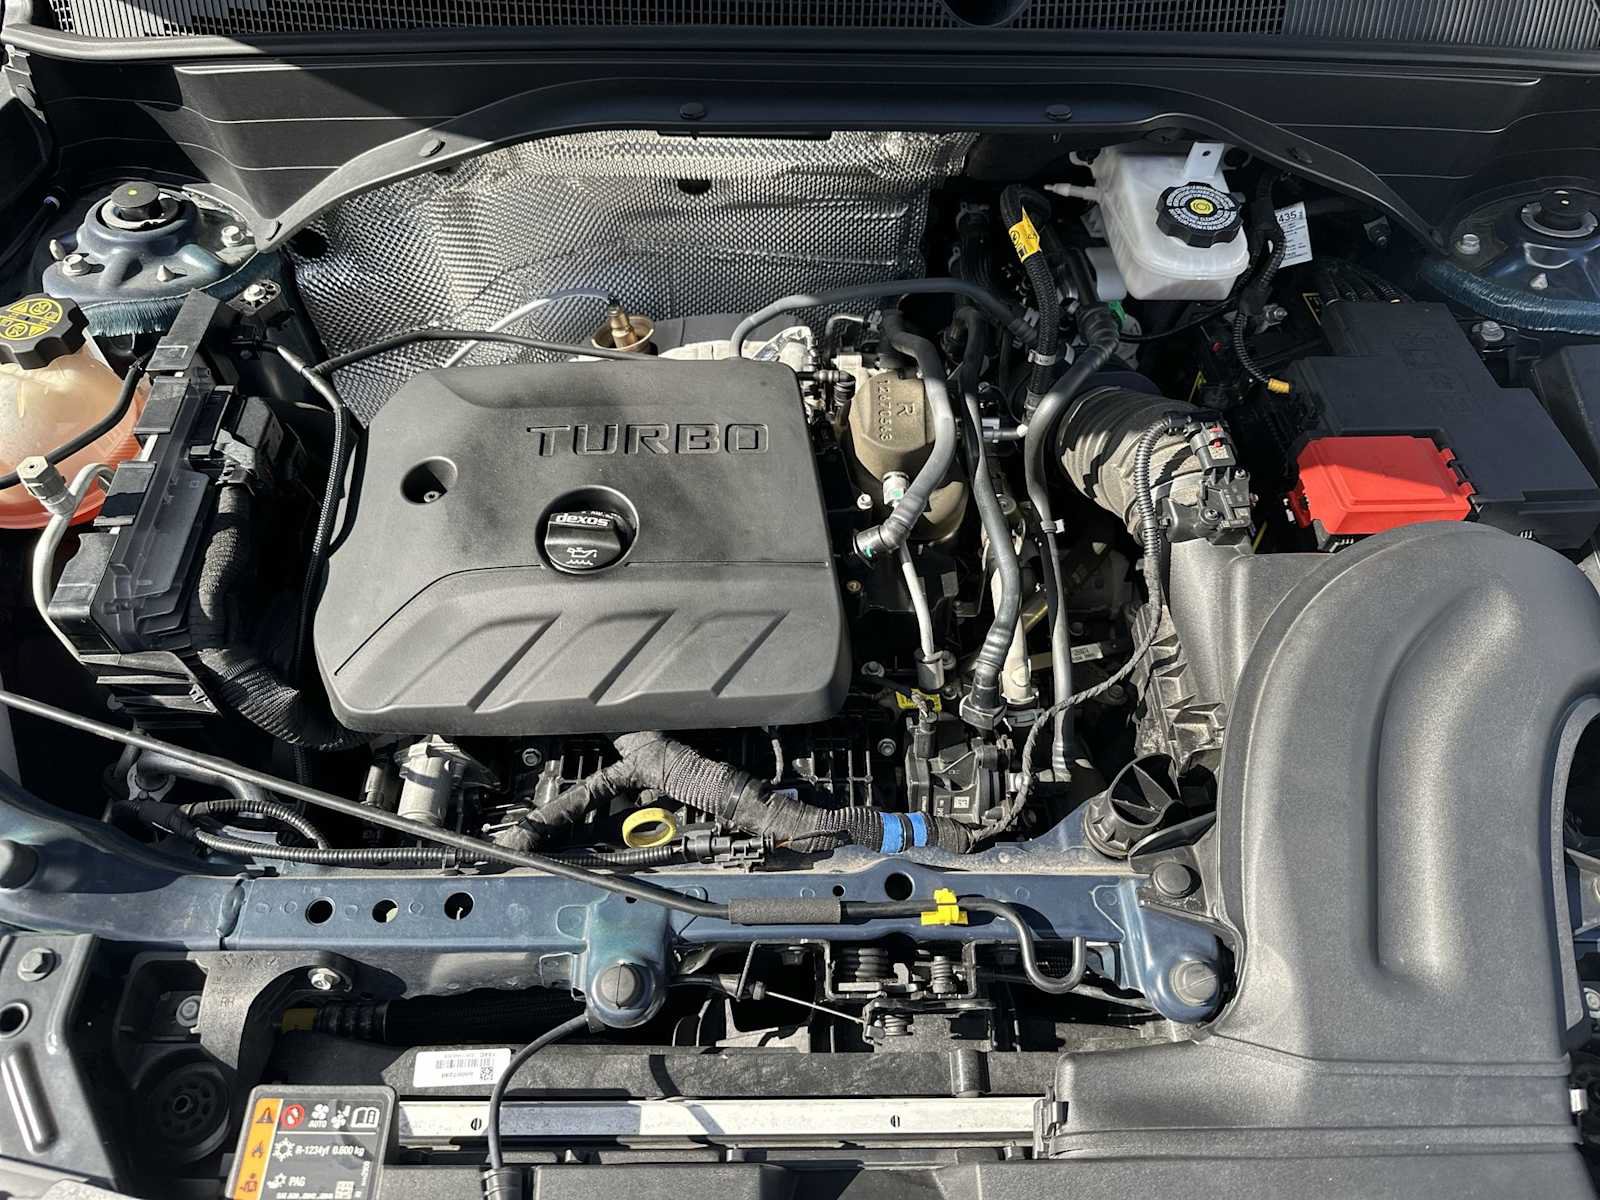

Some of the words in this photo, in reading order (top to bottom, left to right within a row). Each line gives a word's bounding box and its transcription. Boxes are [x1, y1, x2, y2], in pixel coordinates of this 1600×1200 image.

[896, 402, 916, 416] R
[527, 423, 768, 457] TURBO
[556, 513, 611, 527] dexos
[309, 1120, 327, 1128] AUTO
[354, 1145, 365, 1157] kg
[288, 1176, 306, 1187] PAG
